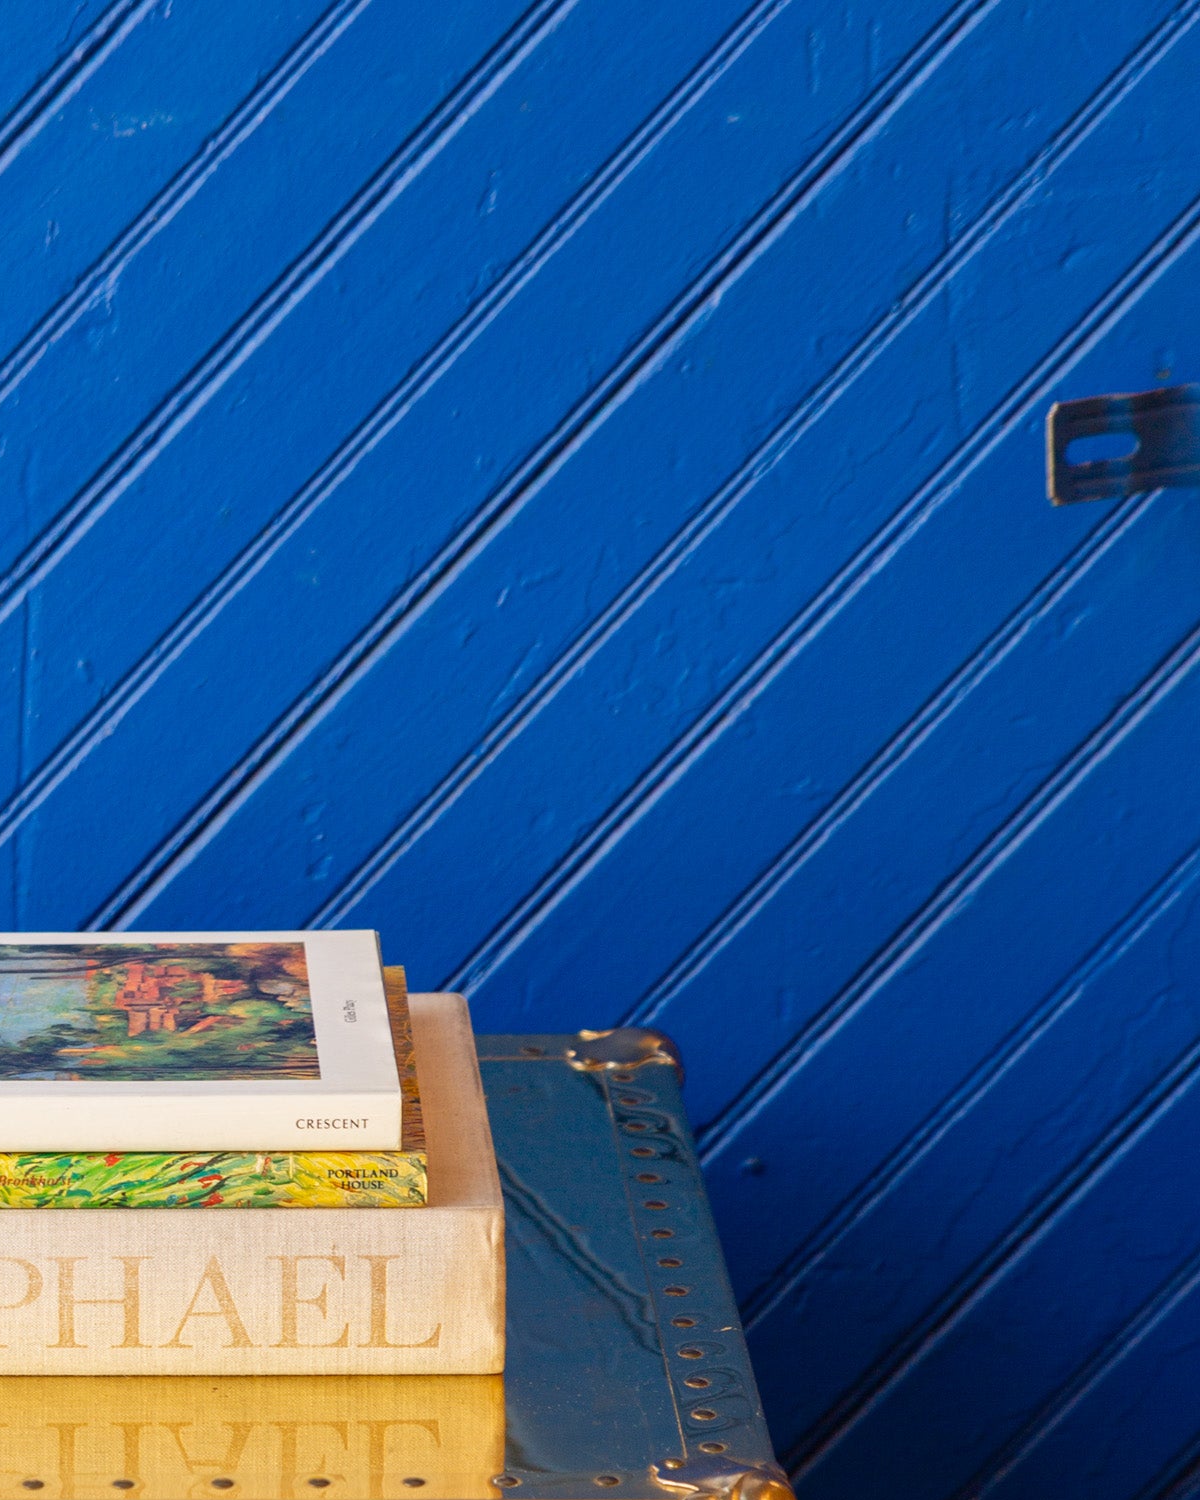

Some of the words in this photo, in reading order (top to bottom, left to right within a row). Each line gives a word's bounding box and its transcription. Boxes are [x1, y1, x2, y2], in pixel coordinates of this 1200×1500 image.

[296, 1118, 369, 1129] CRESCENT
[327, 1169, 399, 1179] PORTLAND
[341, 1180, 384, 1190] HOUSE
